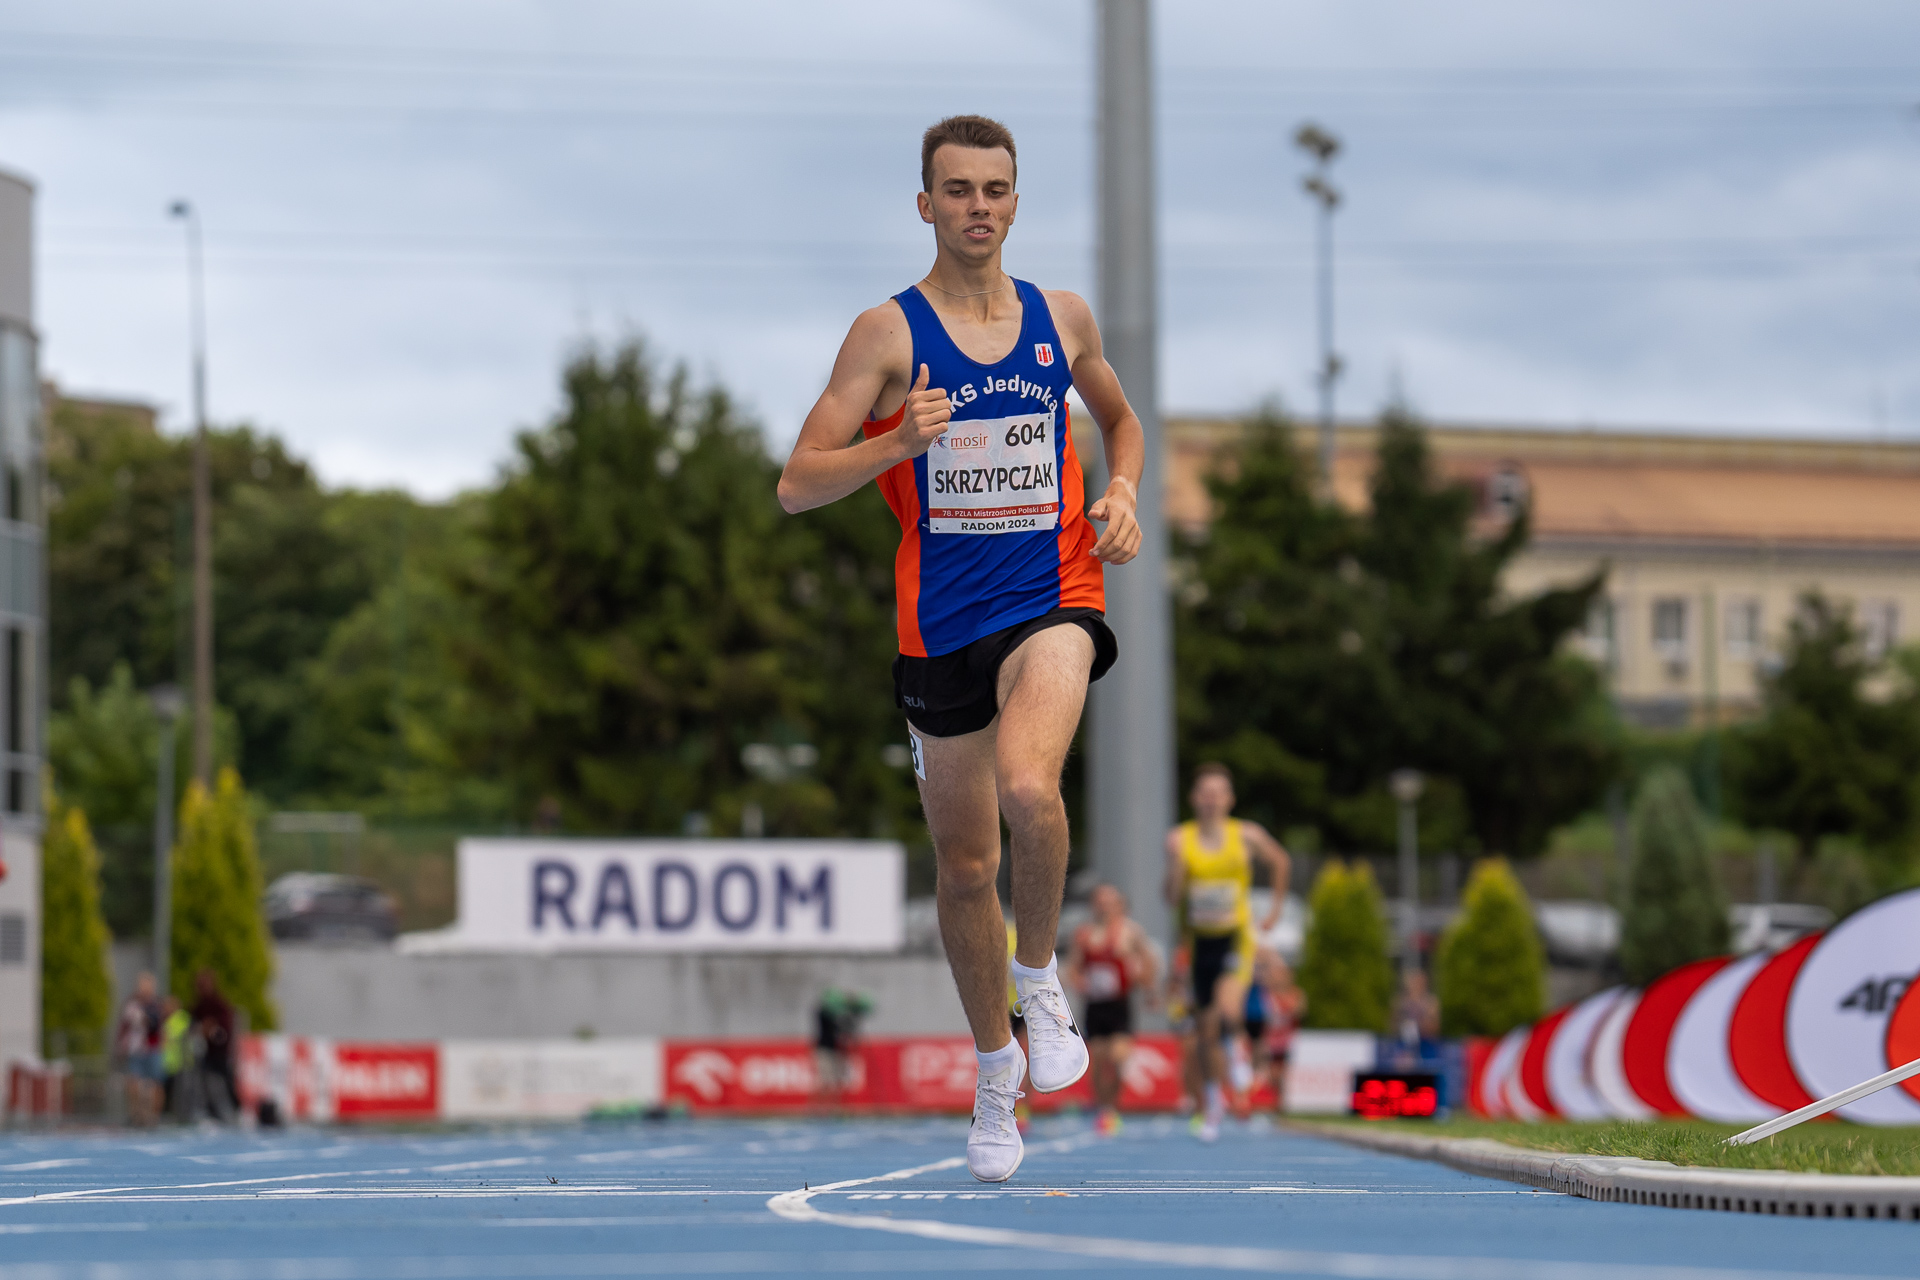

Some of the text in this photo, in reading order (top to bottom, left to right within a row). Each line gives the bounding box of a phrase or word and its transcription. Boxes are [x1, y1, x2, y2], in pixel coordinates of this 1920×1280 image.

[982, 374, 1058, 413] Jedynka
[950, 433, 988, 447] mosir
[1005, 421, 1046, 447] 604
[934, 462, 1054, 494] SKRZYPCZAK
[942, 509, 954, 517] 78.
[973, 508, 1017, 517] Mistrzostwa
[1018, 506, 1039, 514] Polski
[1040, 504, 1053, 513] U20
[961, 518, 1036, 531] RADOM 2024
[530, 859, 834, 931] RADOM
